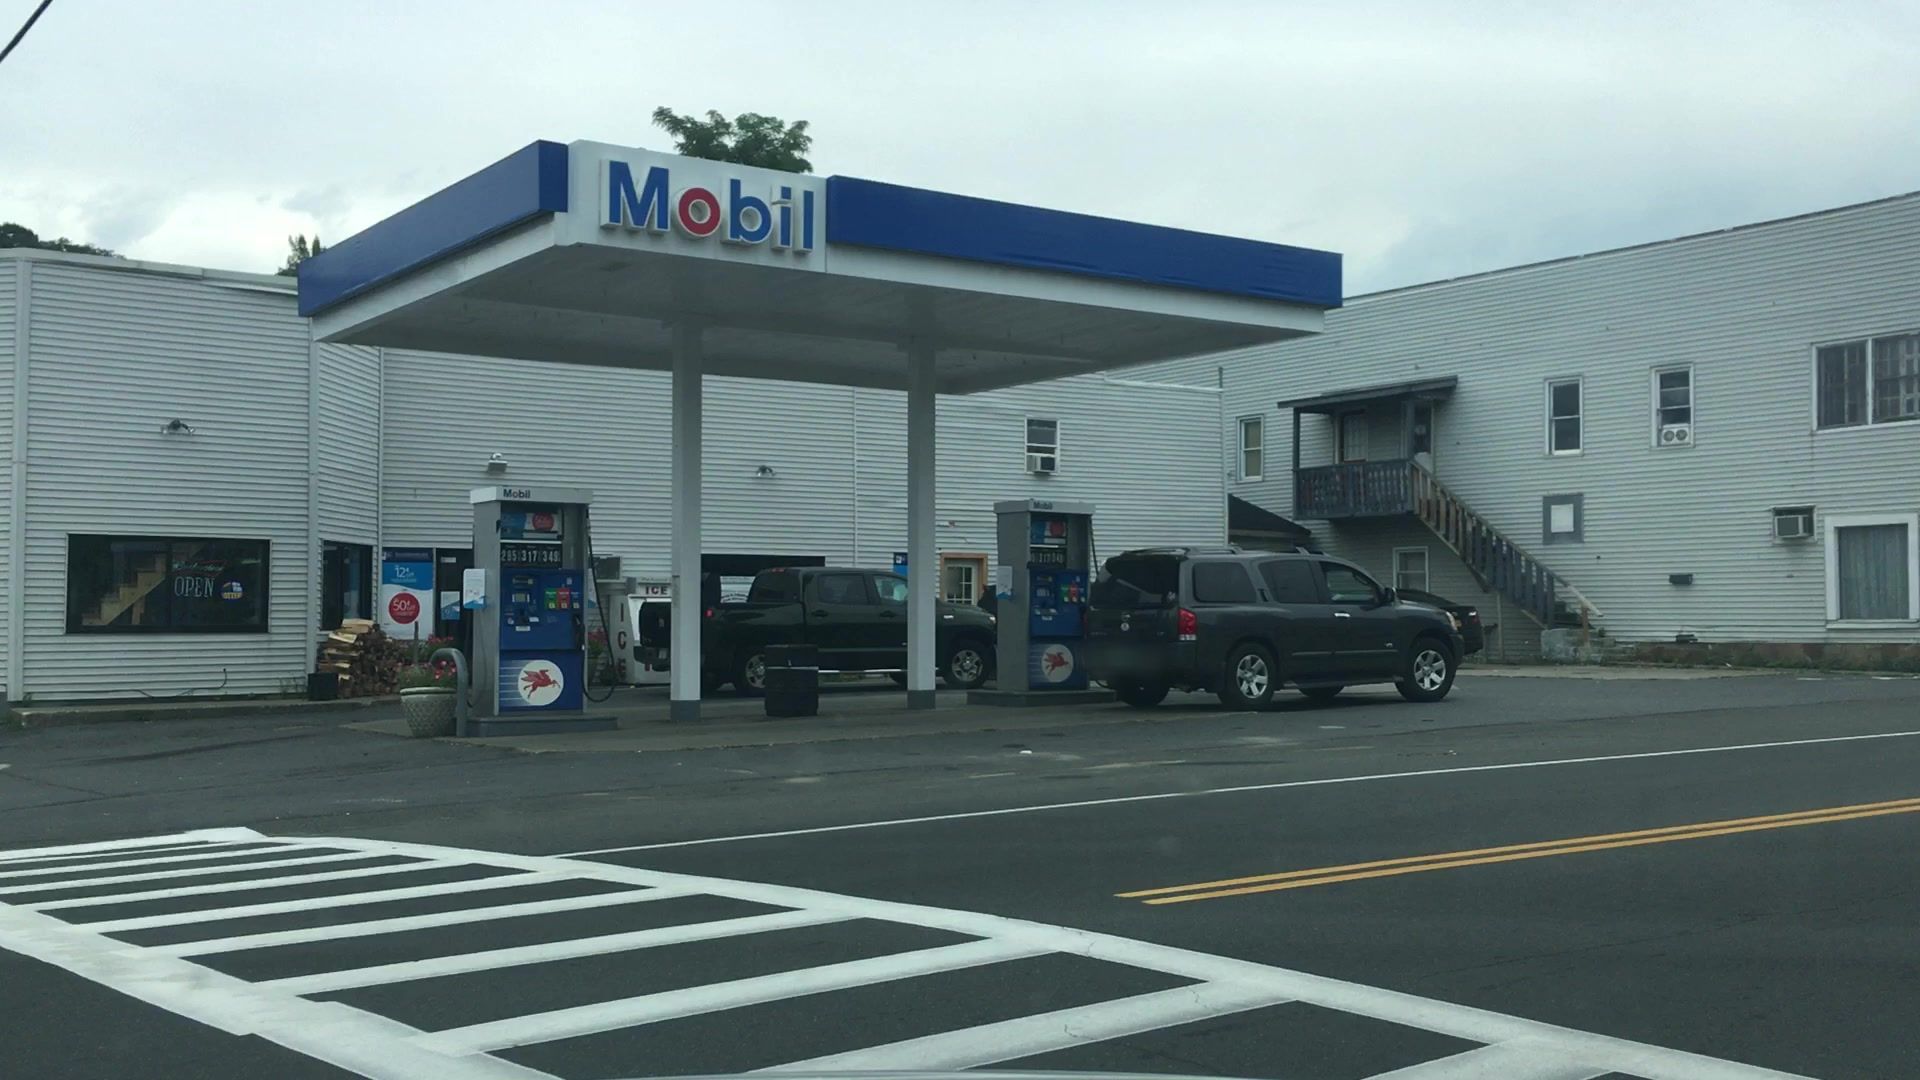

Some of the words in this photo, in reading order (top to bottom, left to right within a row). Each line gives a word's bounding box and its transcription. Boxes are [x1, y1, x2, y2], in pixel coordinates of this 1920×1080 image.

[606, 159, 815, 251] Mobil
[503, 488, 531, 499] Mobil
[174, 576, 215, 598] OPEN
[645, 585, 668, 595] ICE
